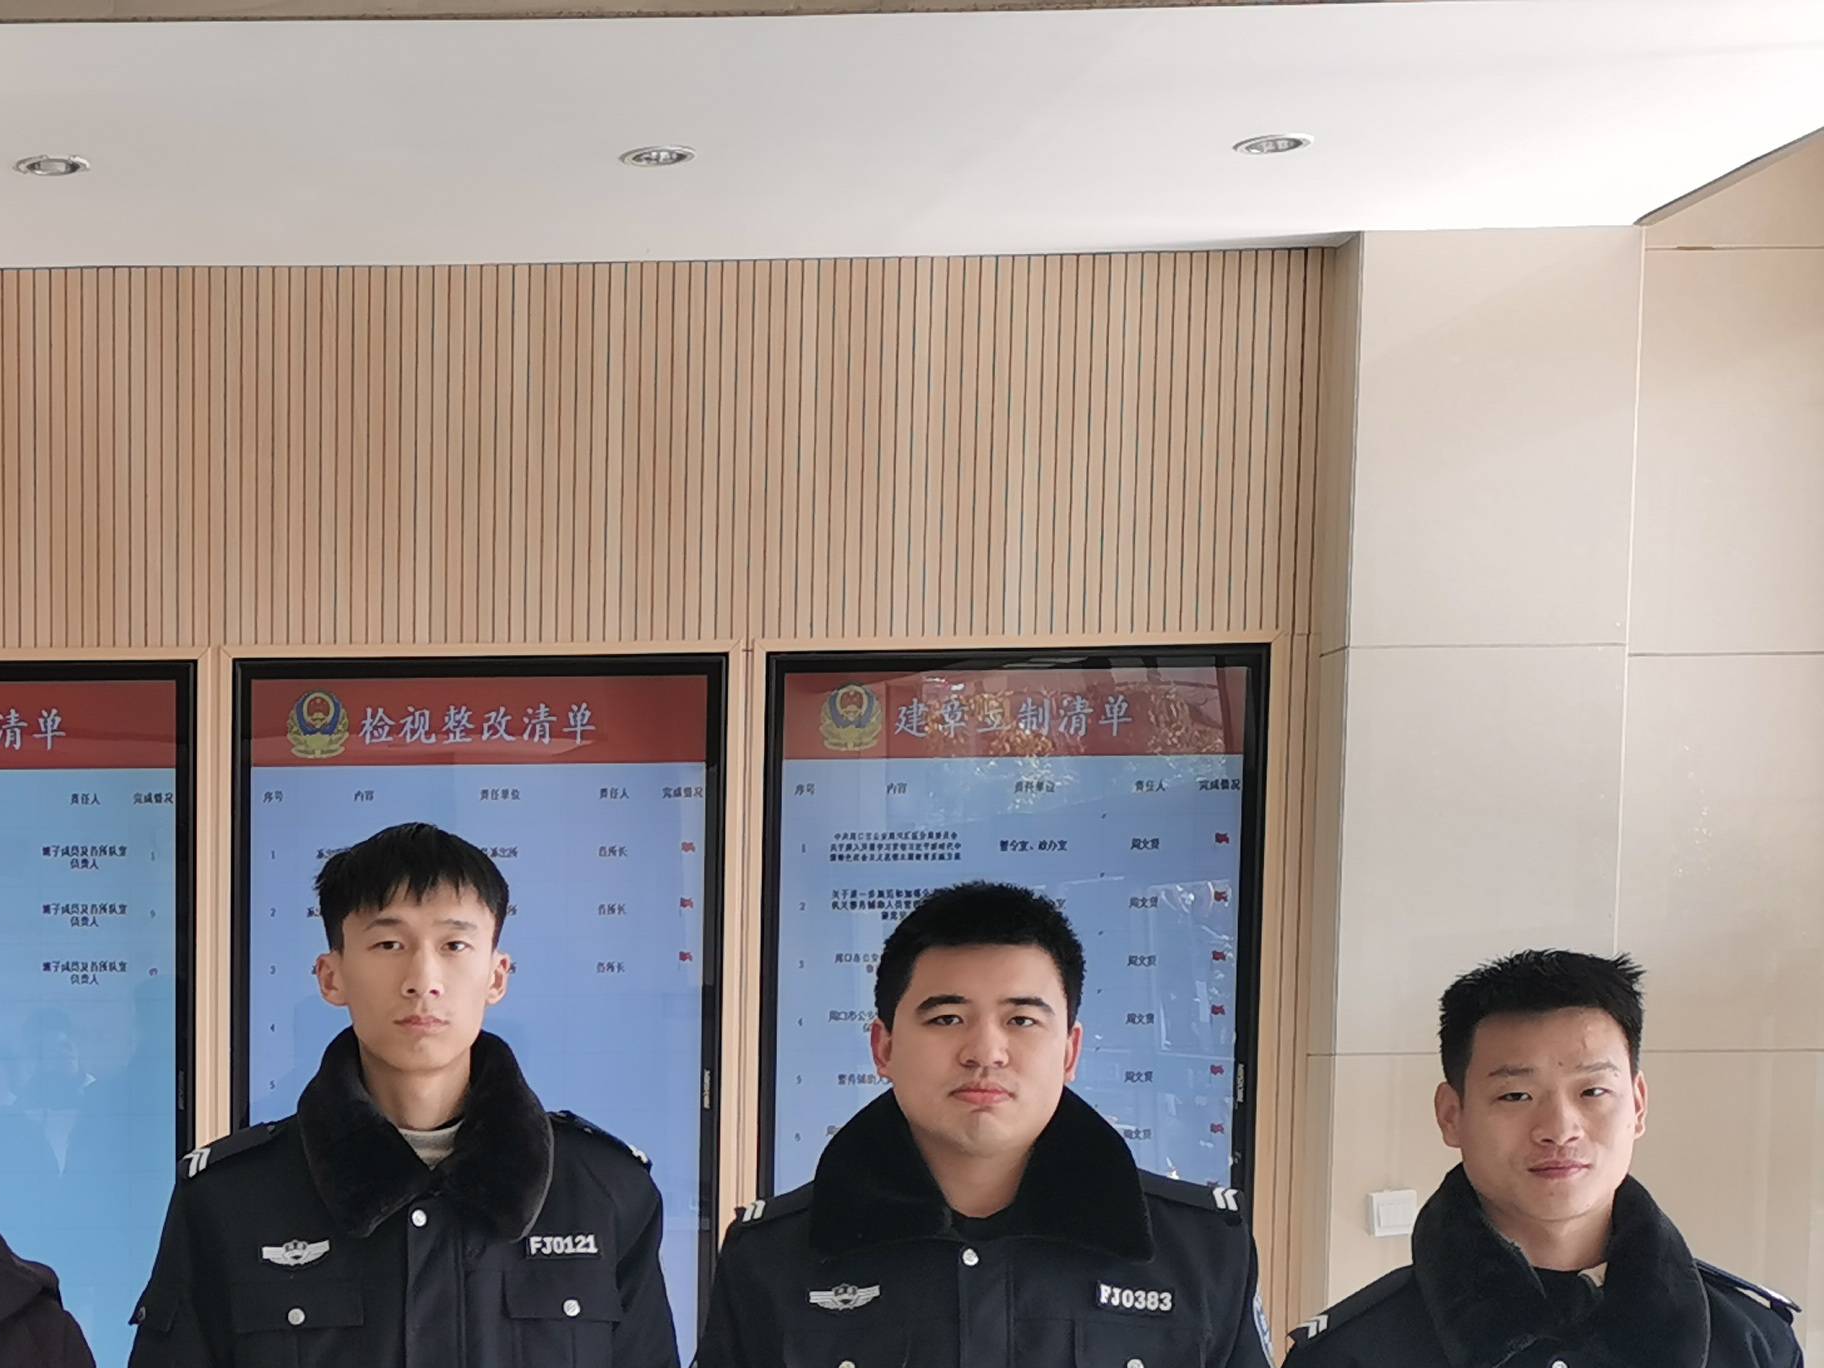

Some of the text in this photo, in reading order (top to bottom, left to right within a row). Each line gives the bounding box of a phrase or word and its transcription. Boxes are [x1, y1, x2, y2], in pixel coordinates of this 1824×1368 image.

[360, 703, 596, 745] 检视整改清单
[895, 696, 1133, 738] 建章立制清单
[529, 1234, 599, 1256] FJ0121
[1098, 1283, 1173, 1312] FJ0383
